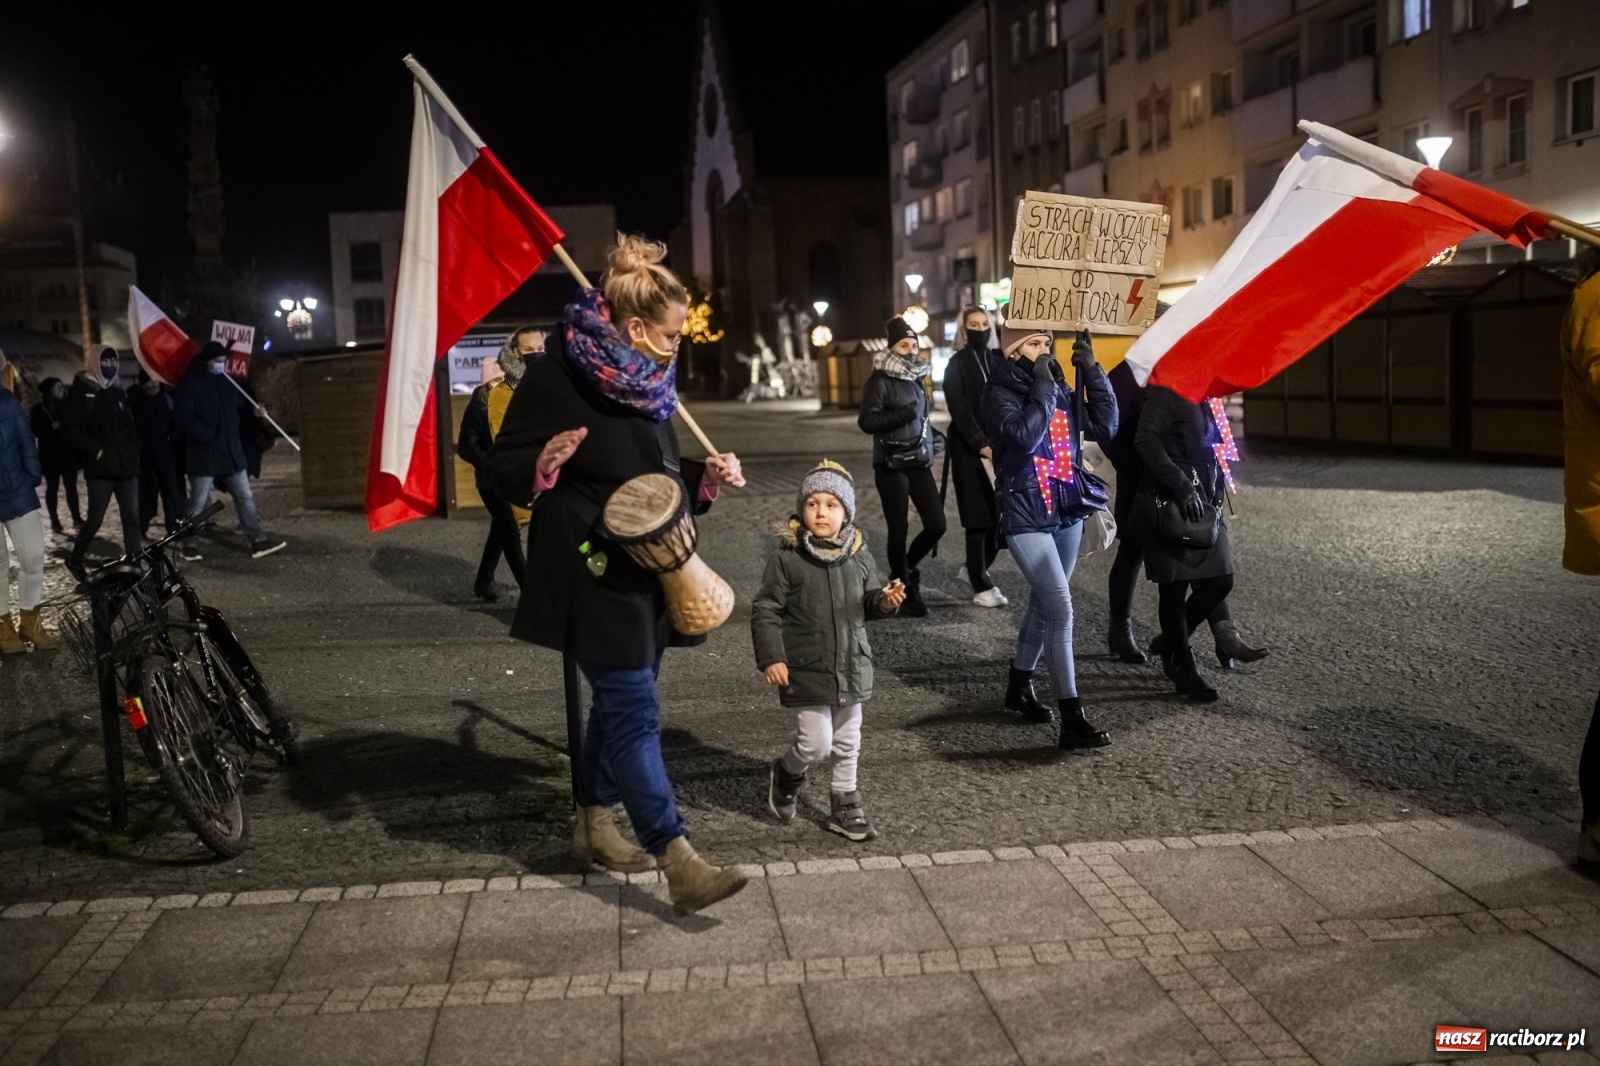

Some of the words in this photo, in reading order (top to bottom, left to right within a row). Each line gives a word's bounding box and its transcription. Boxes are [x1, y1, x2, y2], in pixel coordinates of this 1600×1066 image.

[1028, 205, 1094, 236] STRACH
[1114, 213, 1161, 246] OCZACH
[1019, 231, 1081, 261] KACZORA
[1094, 239, 1148, 267] LEPSZY
[1071, 270, 1094, 289] OD
[1011, 287, 1120, 324] WIBRATORA
[215, 324, 252, 345] WOLNA
